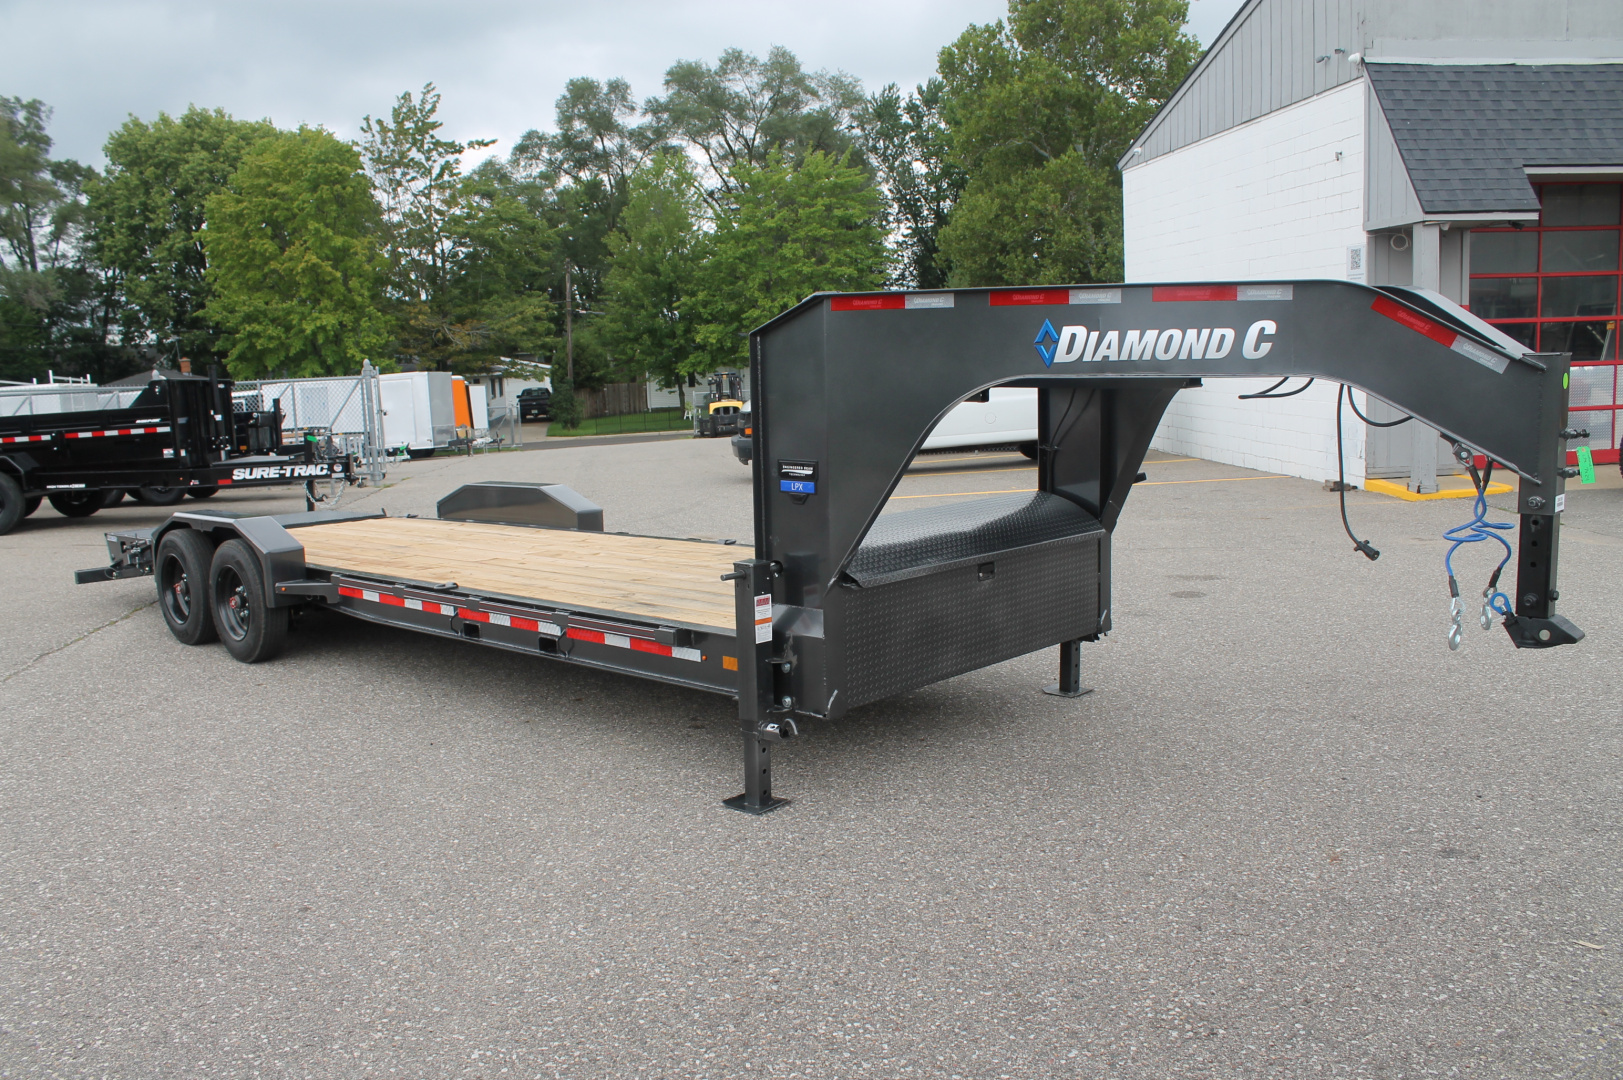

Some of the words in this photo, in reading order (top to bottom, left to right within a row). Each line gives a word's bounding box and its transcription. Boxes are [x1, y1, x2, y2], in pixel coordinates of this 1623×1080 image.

[1053, 325, 1236, 363] DIAMOND
[1242, 319, 1277, 360] C
[232, 464, 329, 480] SURE-TRAC
[791, 482, 803, 491] LPX
